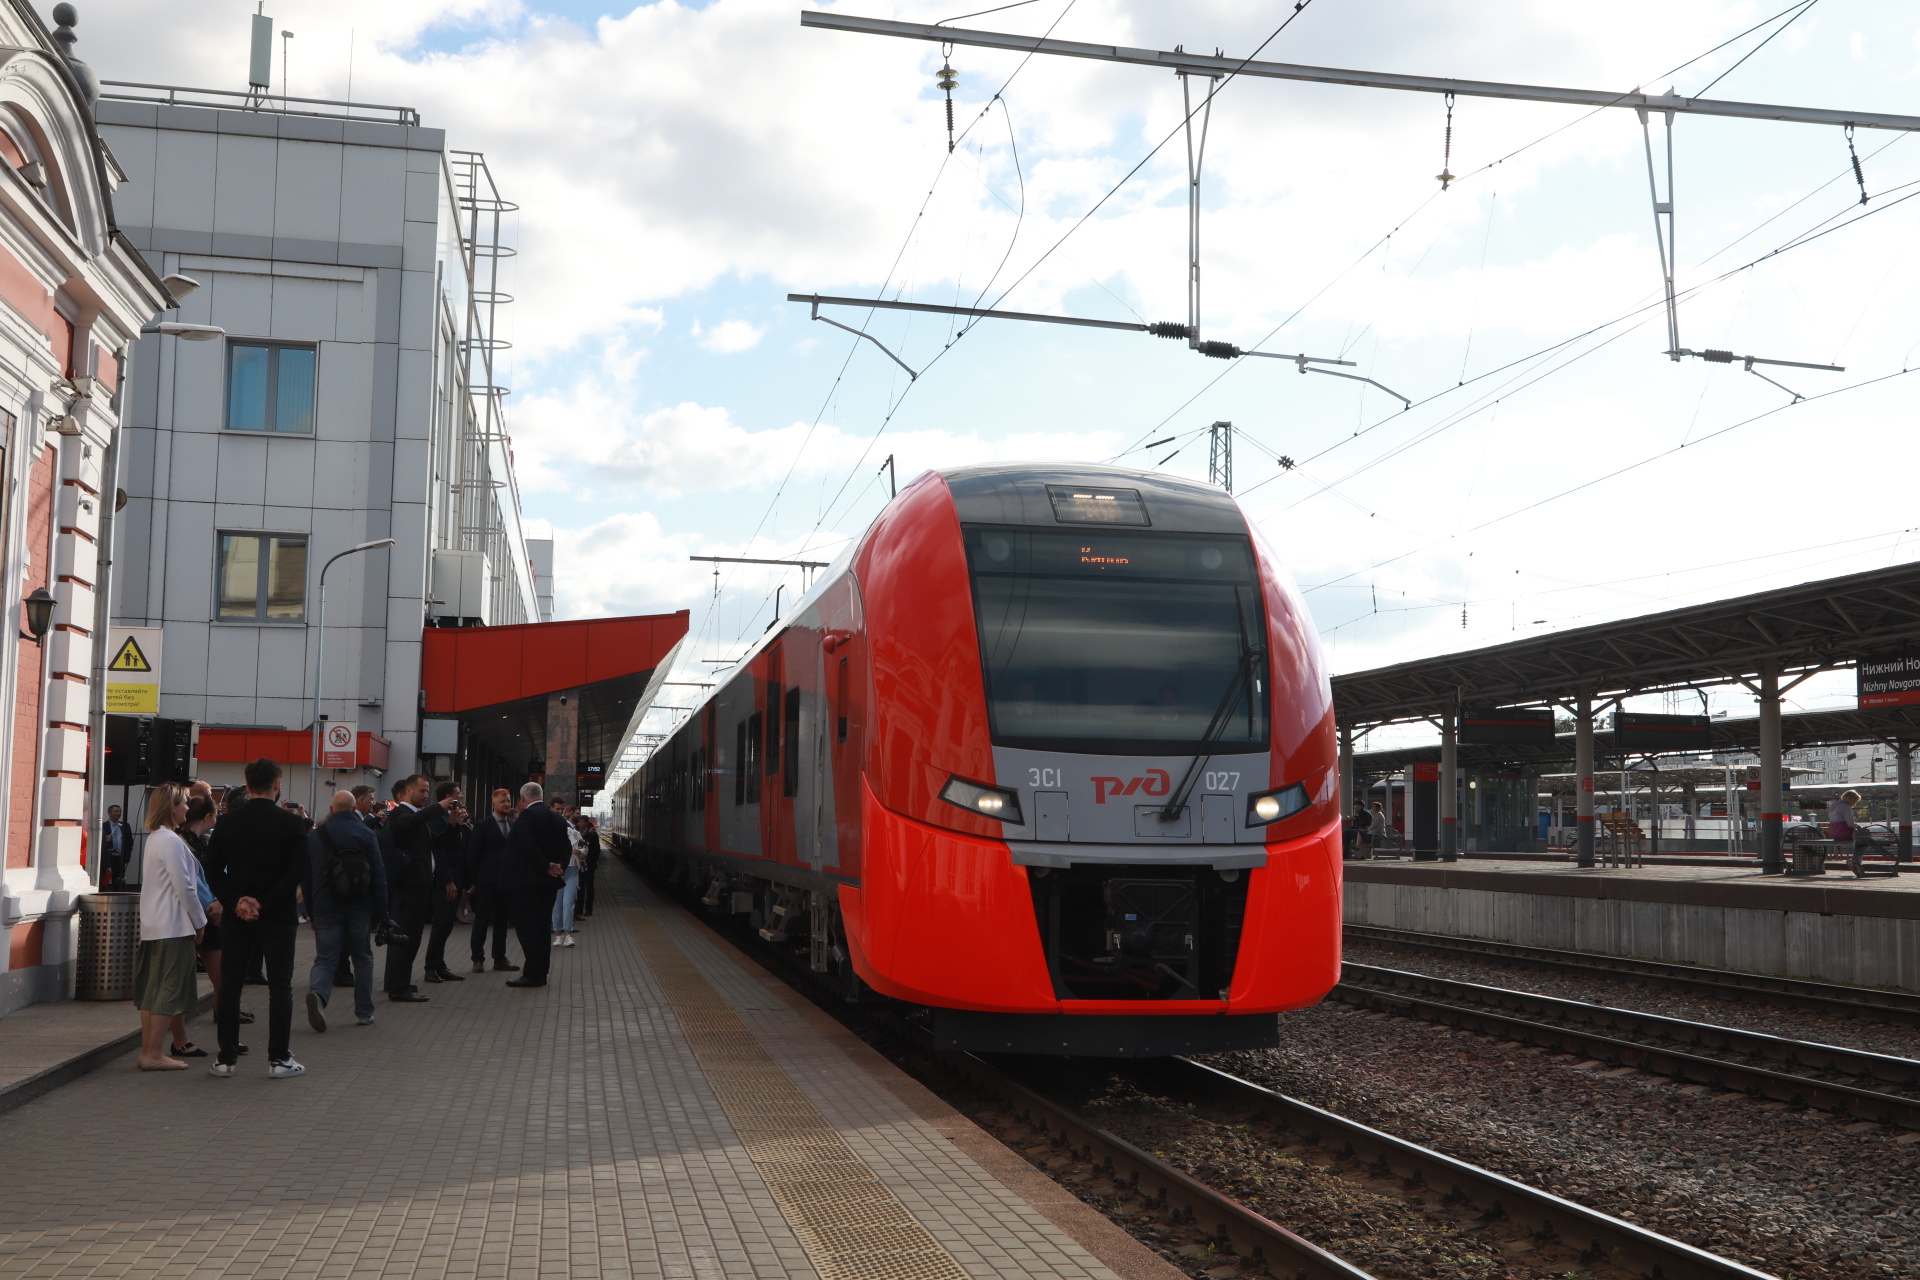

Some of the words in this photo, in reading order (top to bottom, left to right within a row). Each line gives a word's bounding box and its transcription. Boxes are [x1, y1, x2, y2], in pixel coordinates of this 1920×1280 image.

[1862, 658, 1904, 675] Нижний
[1906, 657, 1920, 670] Но
[1863, 681, 1888, 692] Nizhny
[1464, 711, 1469, 719] 6
[1205, 771, 1240, 791] 027
